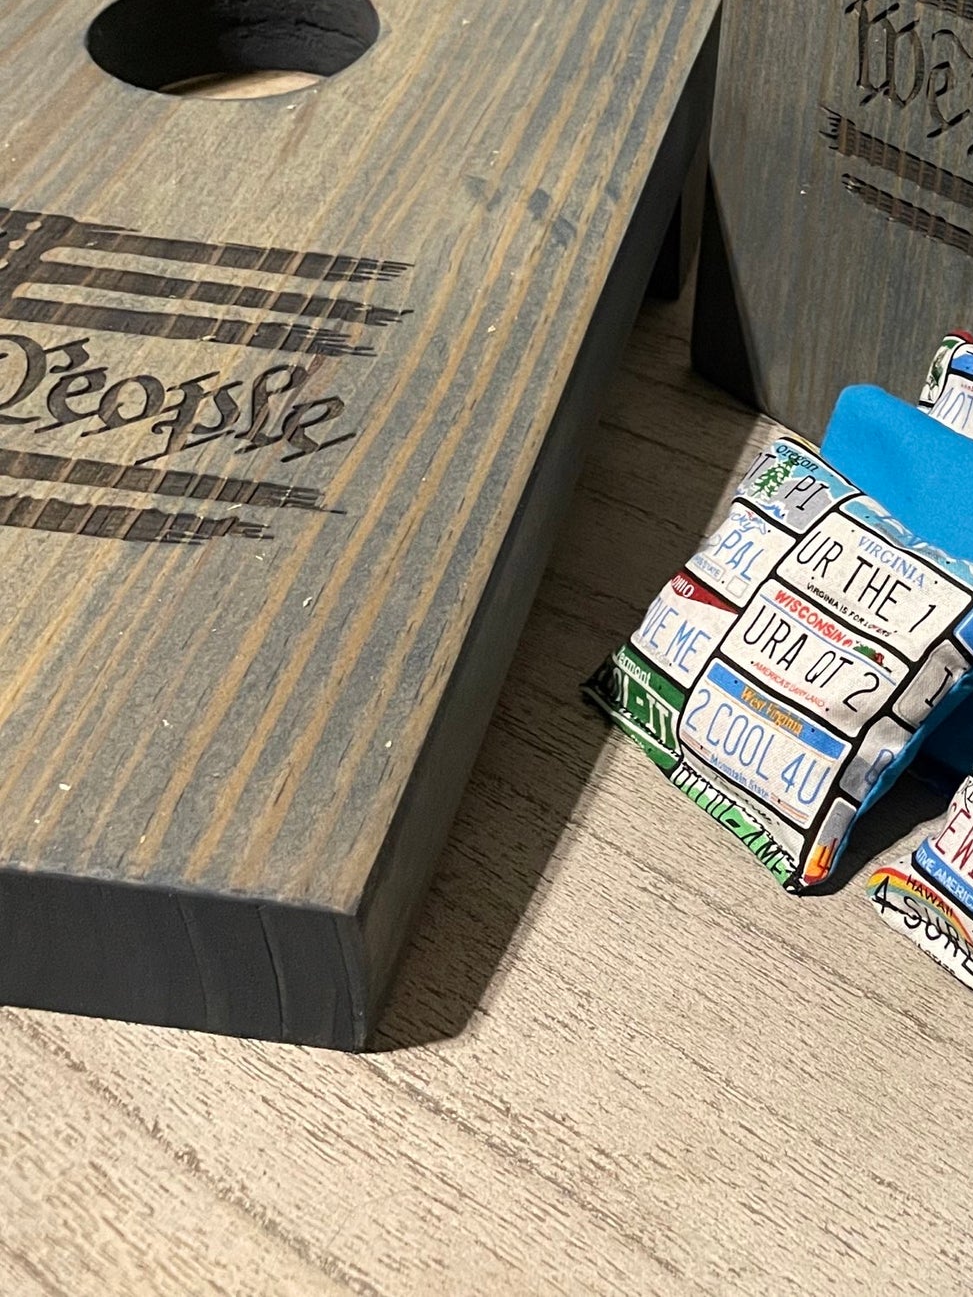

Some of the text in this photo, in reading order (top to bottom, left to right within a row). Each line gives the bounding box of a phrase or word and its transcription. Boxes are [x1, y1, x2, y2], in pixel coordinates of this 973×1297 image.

[776, 444, 820, 475] Oregon
[785, 475, 829, 512] PI
[714, 529, 764, 581] PAL
[857, 535, 926, 589] VIRGINIA
[671, 574, 695, 598] OHIO
[796, 531, 937, 633] UR THE 1
[806, 581, 839, 608] VIRGINIA
[848, 610, 864, 627] FOR
[773, 589, 845, 647] WISCONSIN
[665, 620, 711, 673] ME
[742, 605, 809, 671] URA
[804, 650, 854, 689] QT
[842, 672, 880, 713] 2
[742, 685, 804, 736] West Virginia
[706, 703, 775, 781] COOL
[780, 753, 831, 805] 4U
[709, 754, 748, 785] Mountain
[906, 874, 954, 917] HAWAII
